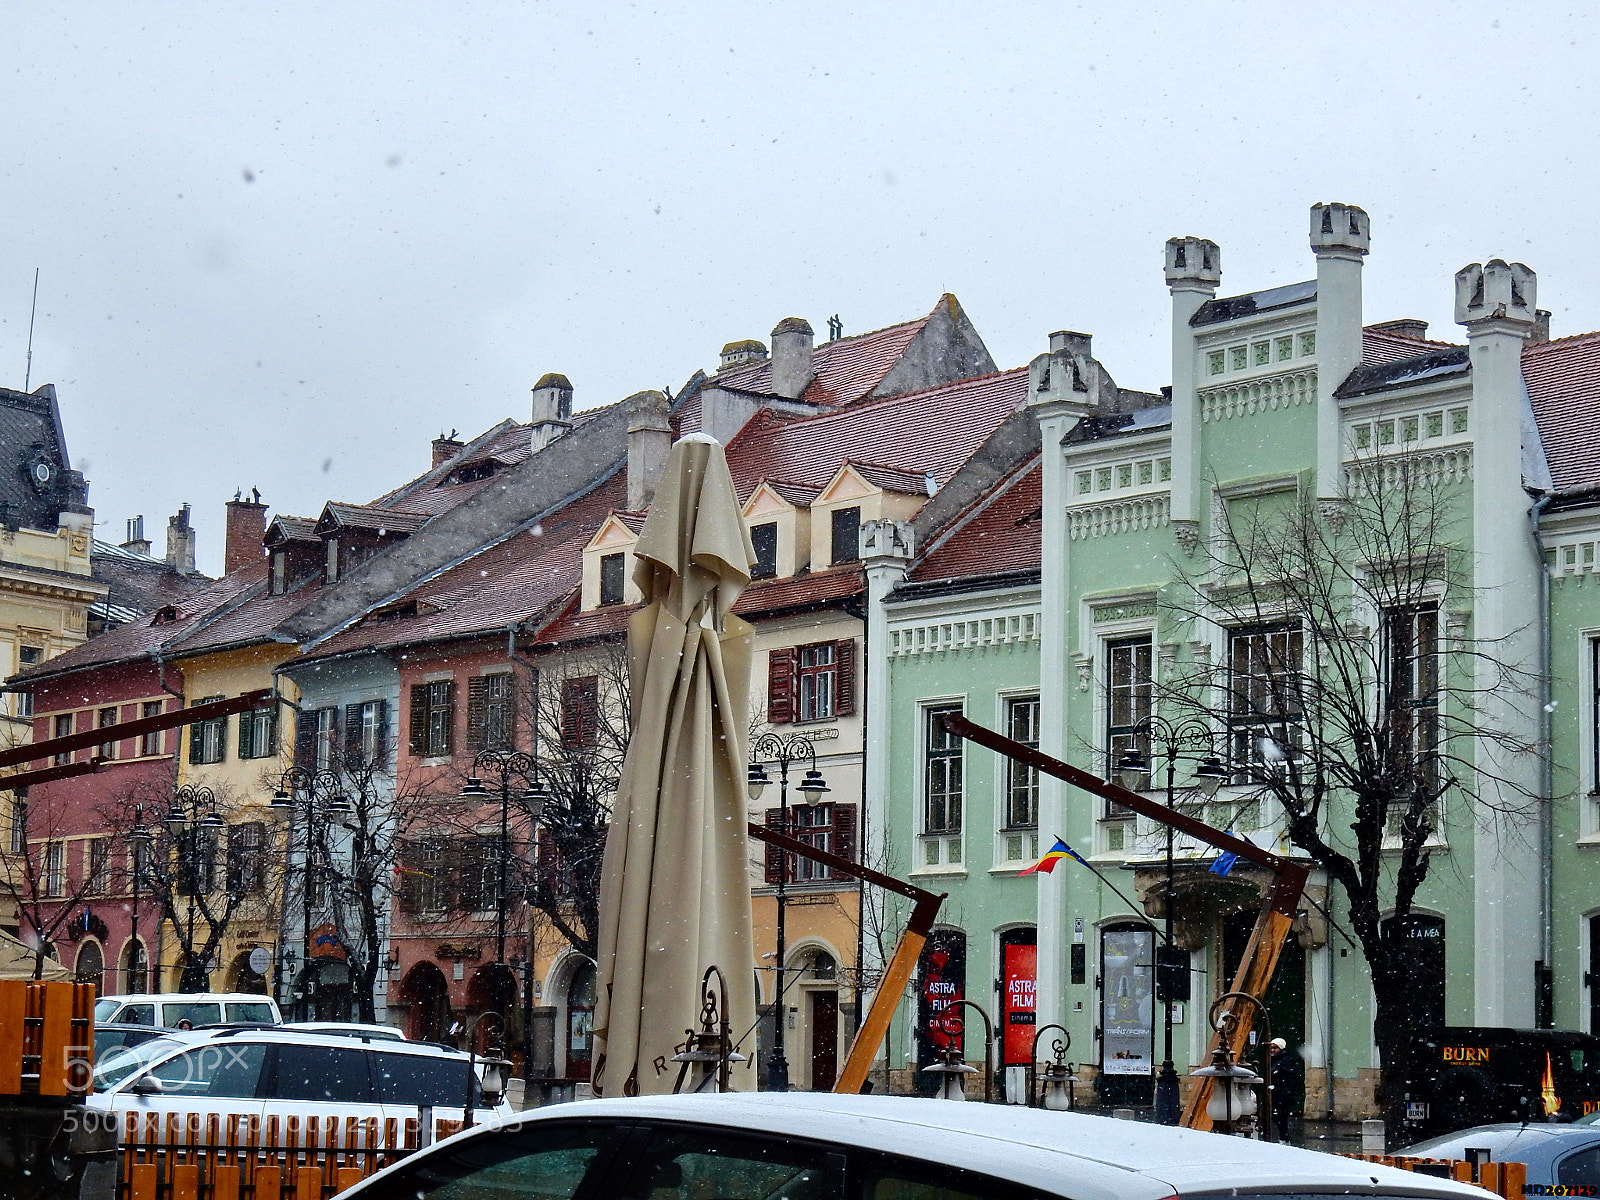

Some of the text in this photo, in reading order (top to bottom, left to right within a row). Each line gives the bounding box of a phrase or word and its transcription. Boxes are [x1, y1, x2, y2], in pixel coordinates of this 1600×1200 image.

[929, 982, 956, 994] ASTRA
[1008, 980, 1037, 993] ASTRA
[1012, 994, 1034, 1007] FILM
[1443, 1046, 1490, 1062] BURN
